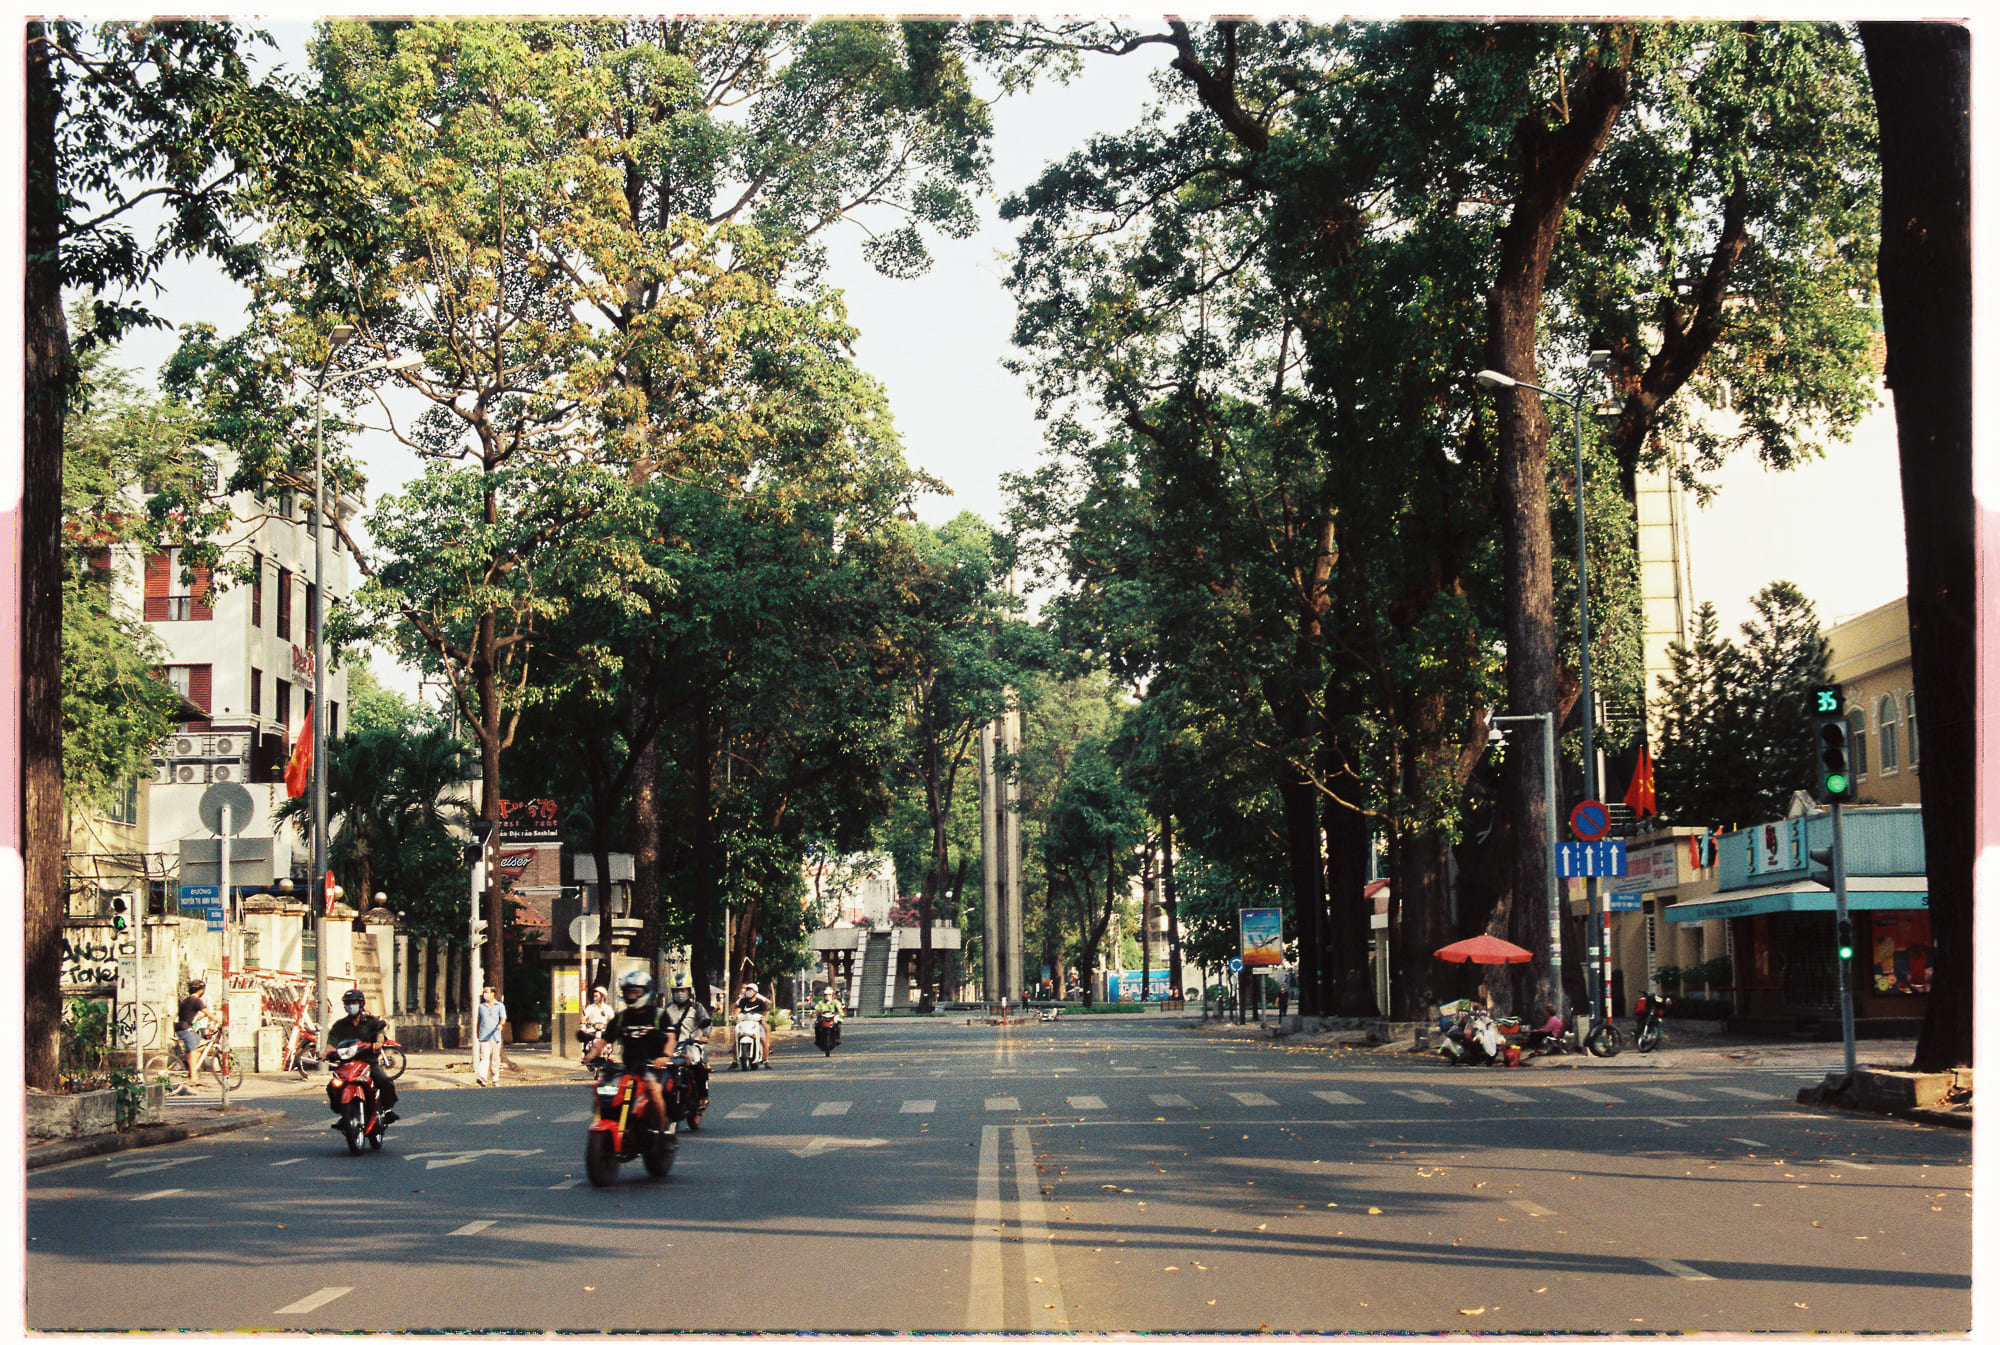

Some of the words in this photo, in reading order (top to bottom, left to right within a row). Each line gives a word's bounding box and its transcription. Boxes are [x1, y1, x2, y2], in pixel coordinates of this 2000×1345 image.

[1817, 691, 1837, 711] 35
[537, 799, 557, 819] 79
[501, 856, 532, 867] eiser
